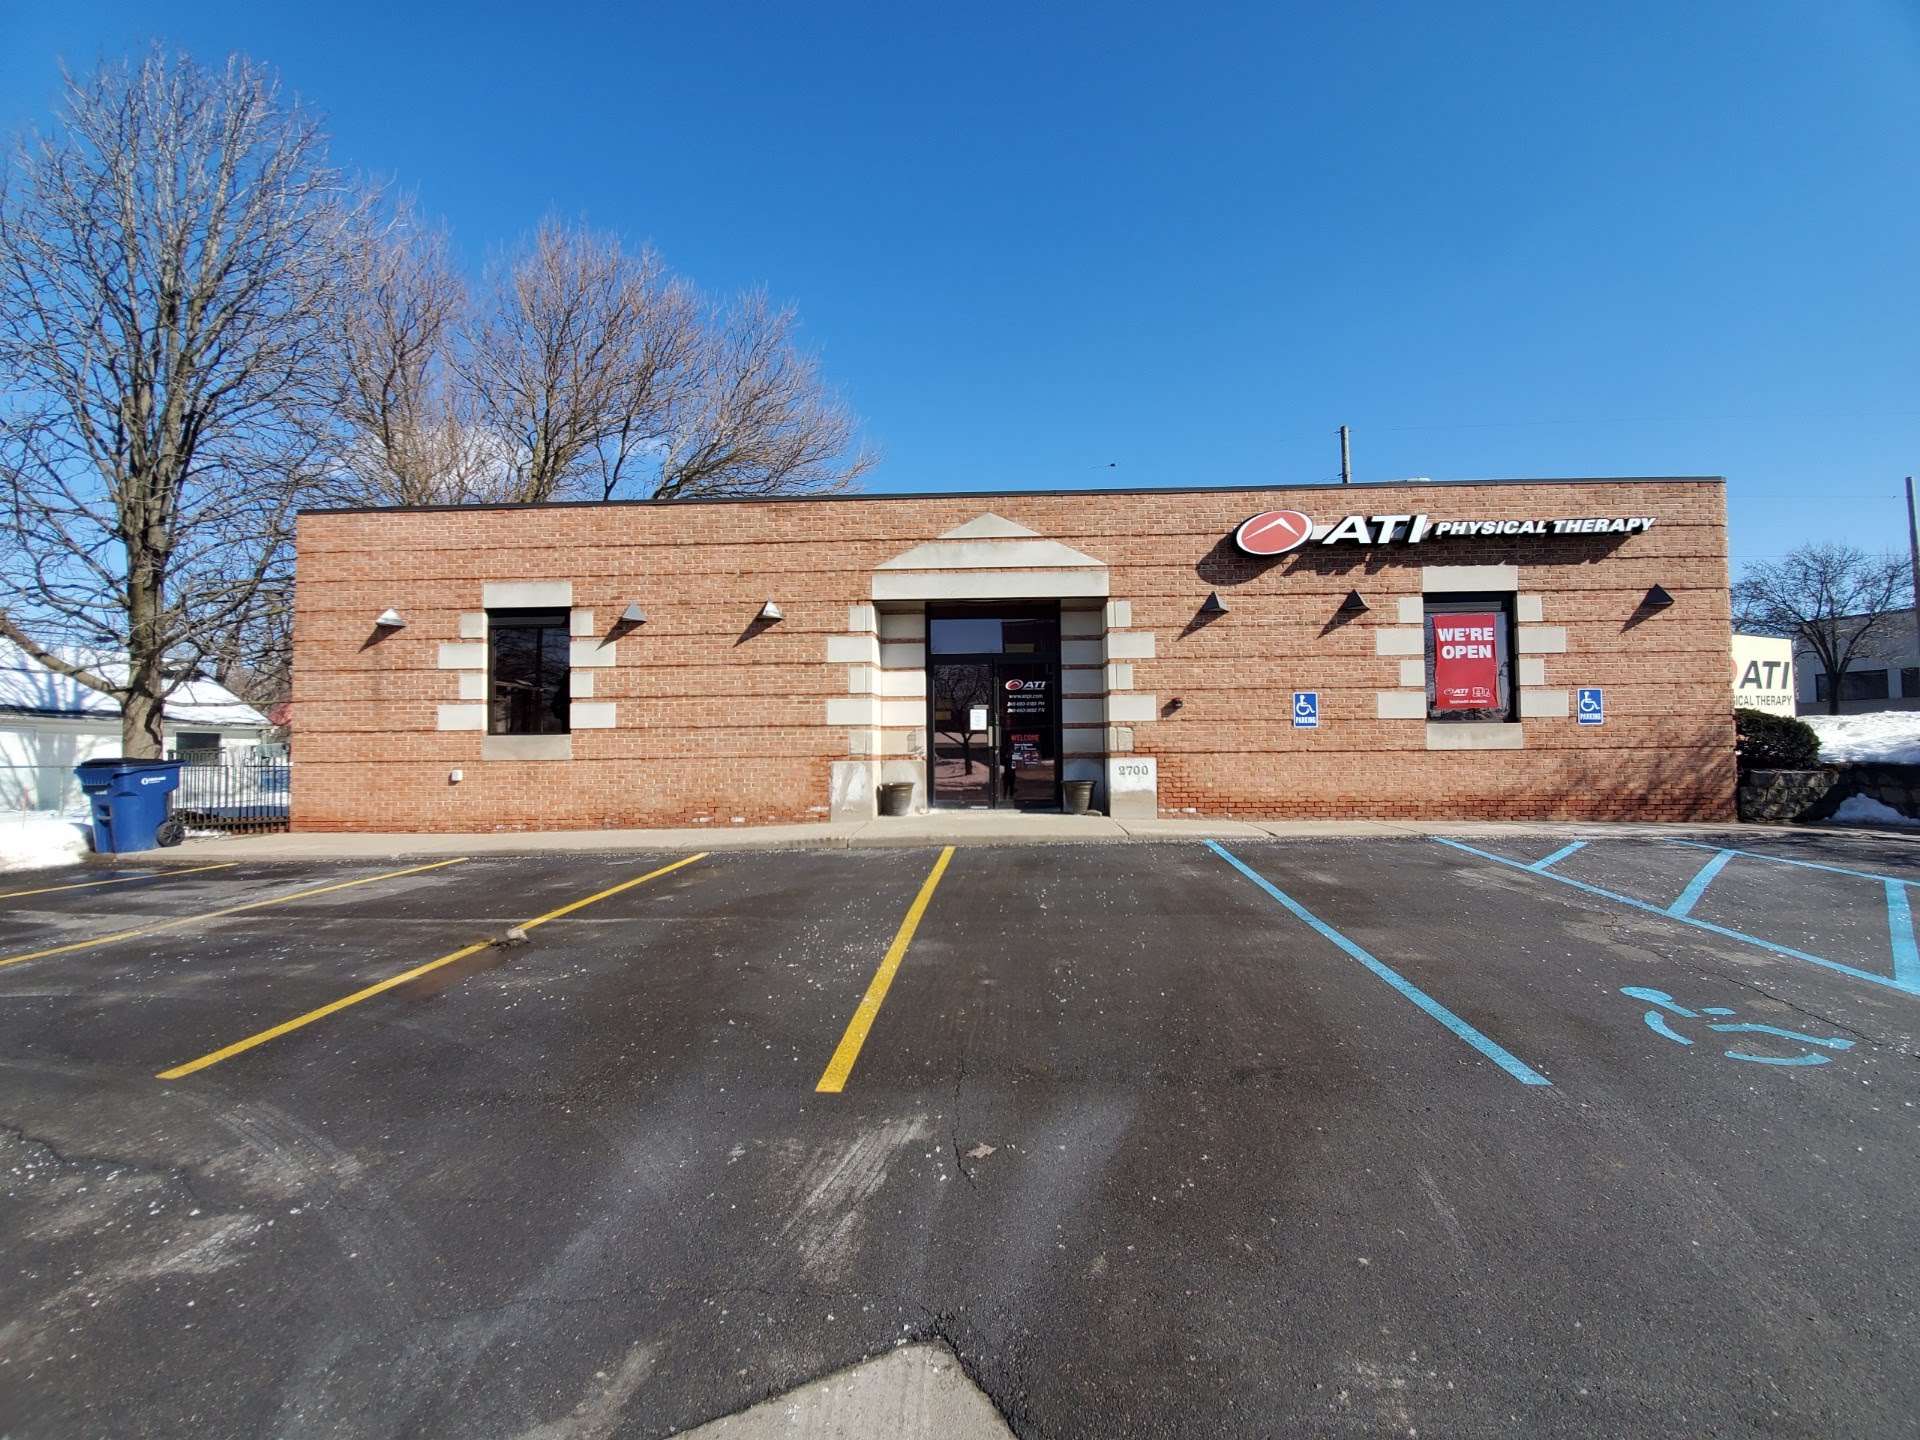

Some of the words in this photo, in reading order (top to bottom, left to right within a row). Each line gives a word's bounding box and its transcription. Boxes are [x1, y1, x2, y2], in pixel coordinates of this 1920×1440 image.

[1322, 514, 1428, 545] ATI
[1435, 520, 1548, 536] PHYSICAL
[1552, 517, 1658, 533] THERAPY
[1437, 627, 1495, 642] WE'RE
[1441, 644, 1492, 659] OPEN
[1739, 660, 1790, 689] ATI
[1755, 695, 1792, 706] THERAPY
[1118, 765, 1149, 776] 2700
